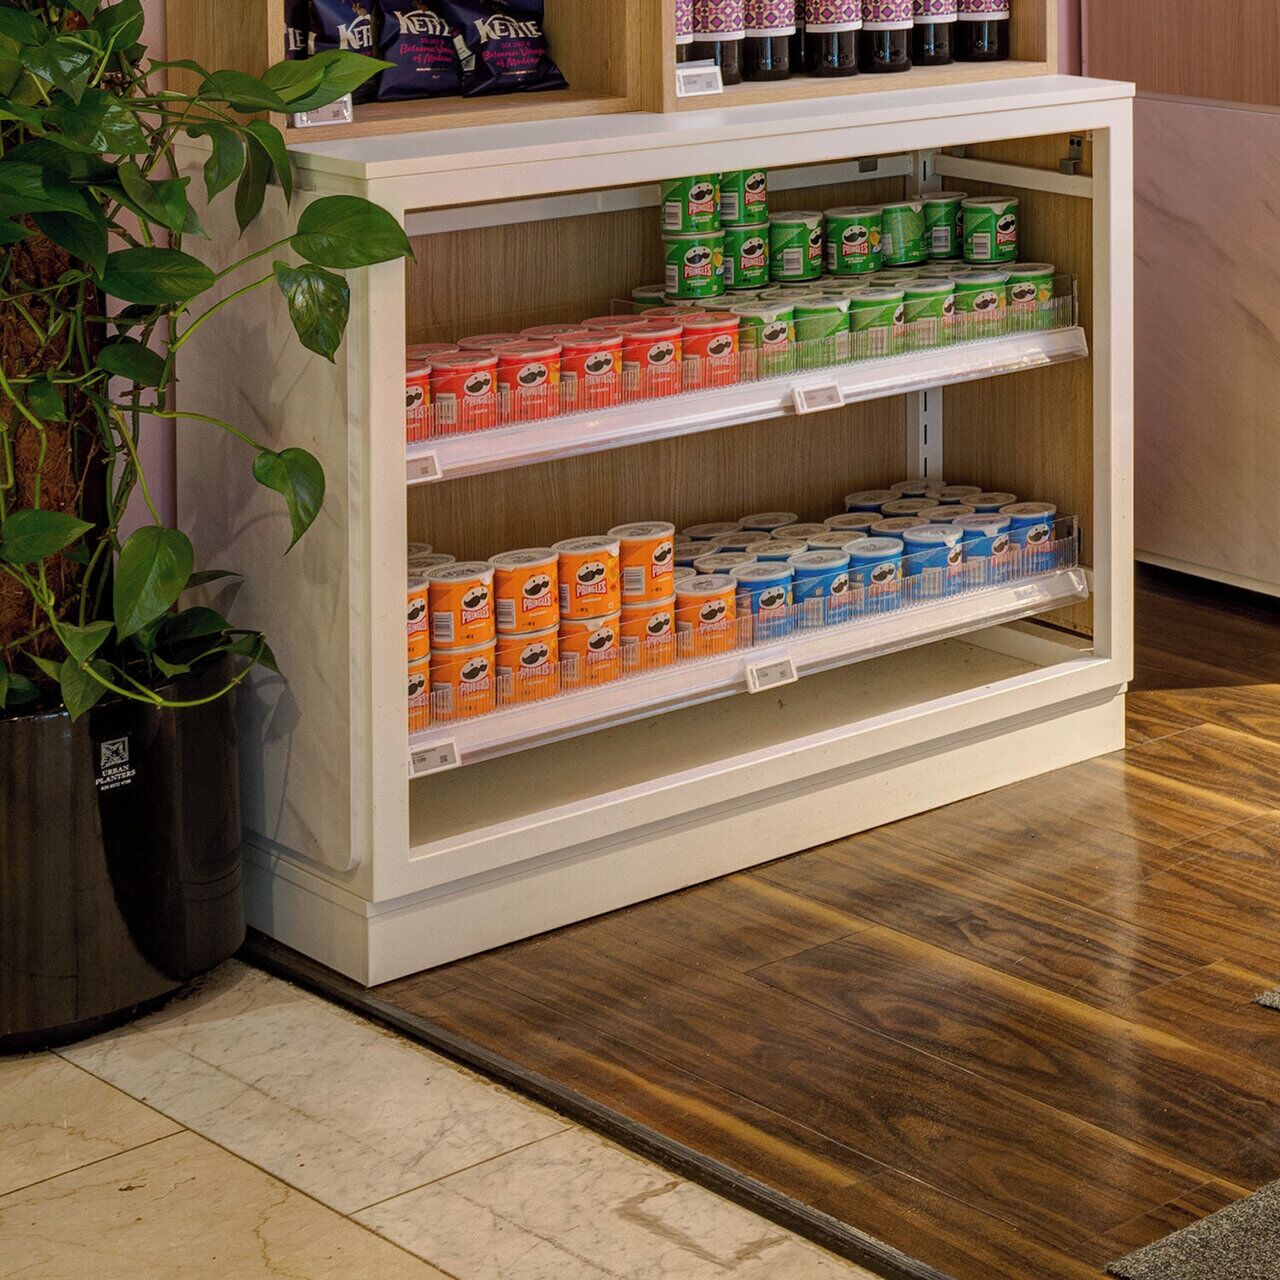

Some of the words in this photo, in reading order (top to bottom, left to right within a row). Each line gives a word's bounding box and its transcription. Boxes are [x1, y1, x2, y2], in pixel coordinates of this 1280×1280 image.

[395, 11, 452, 36] KETTL
[474, 15, 543, 43] KETTLE
[842, 240, 869, 255] PRINGLES
[684, 264, 713, 279] PRINGLES
[577, 581, 608, 598] PRINGLES
[523, 593, 553, 612] PRINGLES
[462, 605, 490, 625] PRINGLES
[95, 769, 137, 785] PLANTERS
[102, 764, 130, 777] URBAN
